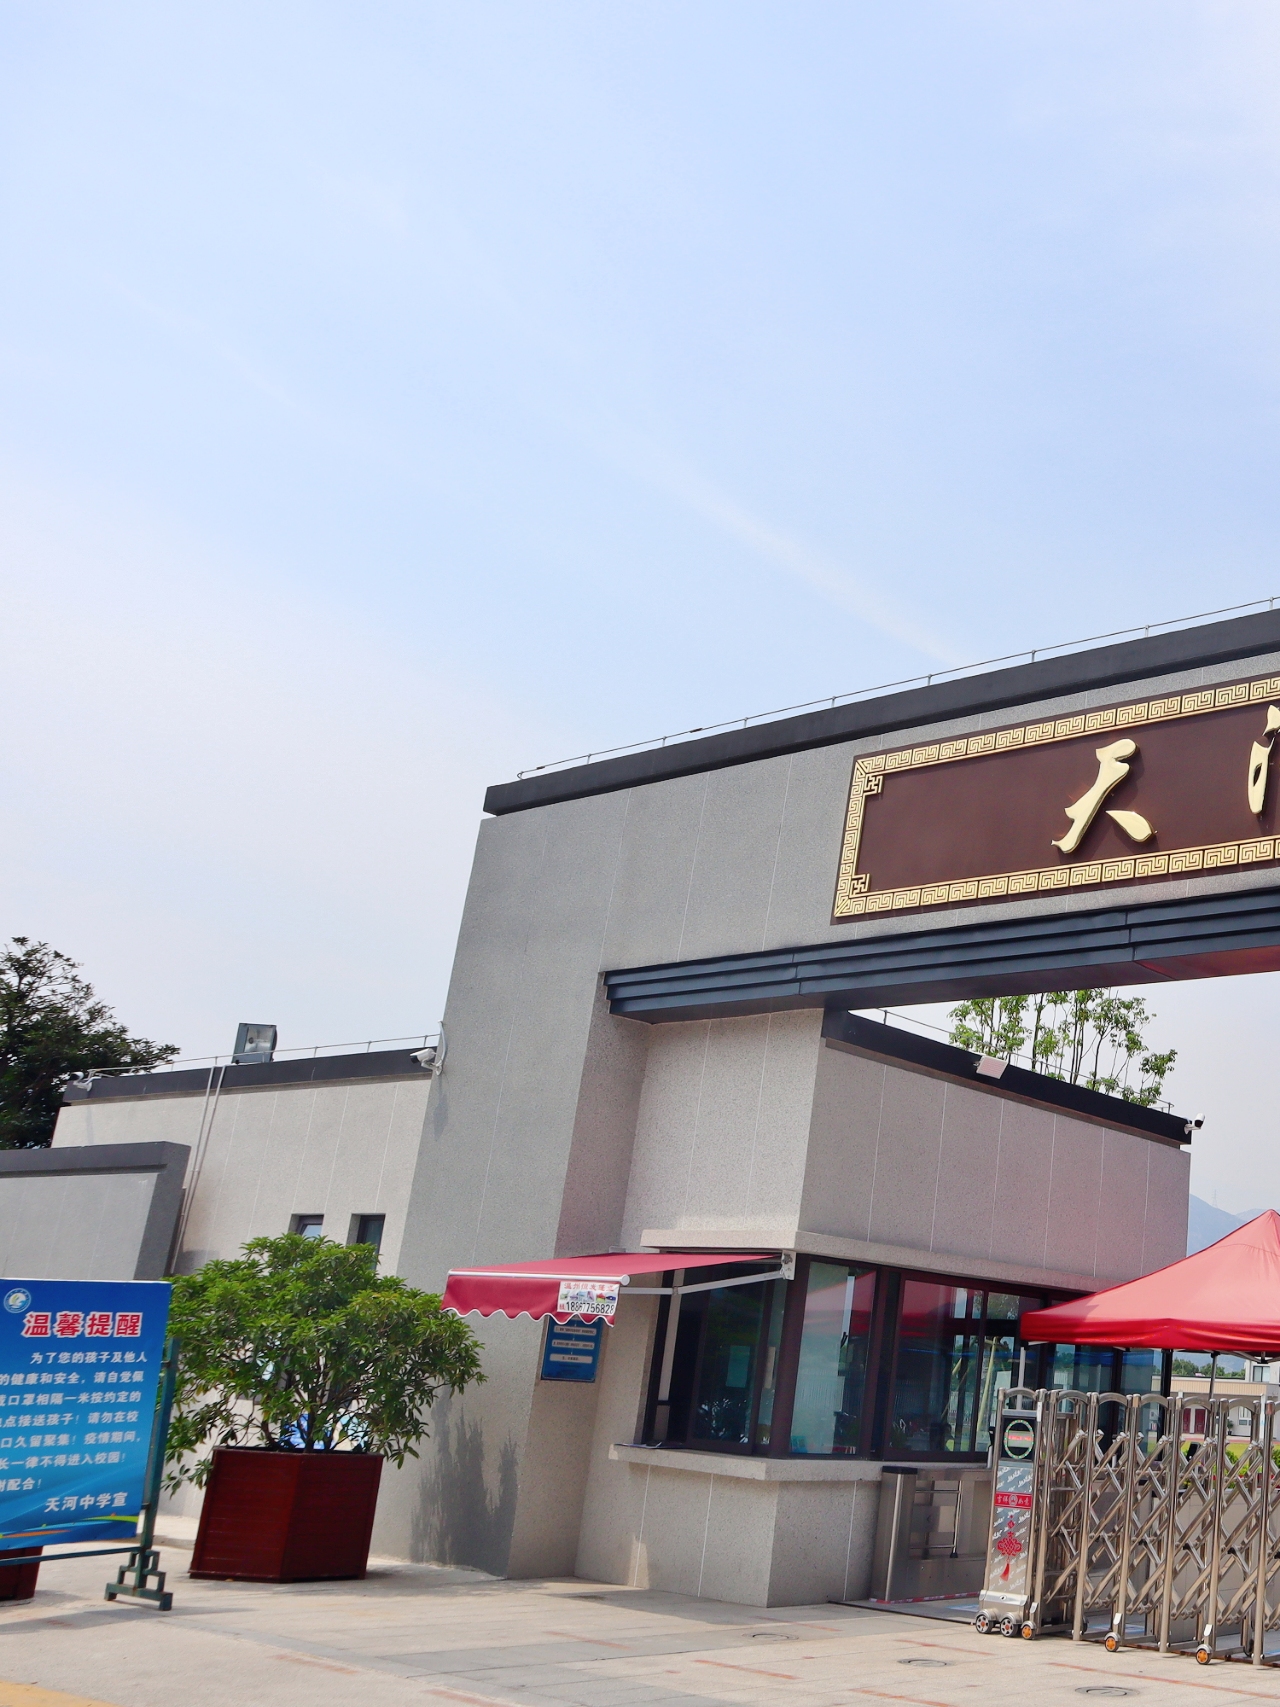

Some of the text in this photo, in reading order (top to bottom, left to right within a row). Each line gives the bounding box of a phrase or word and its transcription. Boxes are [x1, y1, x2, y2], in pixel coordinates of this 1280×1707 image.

[21, 1312, 143, 1338] 温馨提醒
[30, 1351, 148, 1364] 为了您的孩子及他人
[0, 1411, 140, 1428] 点接送孩子！请勿在校
[44, 1492, 128, 1512] 天河中学宣
